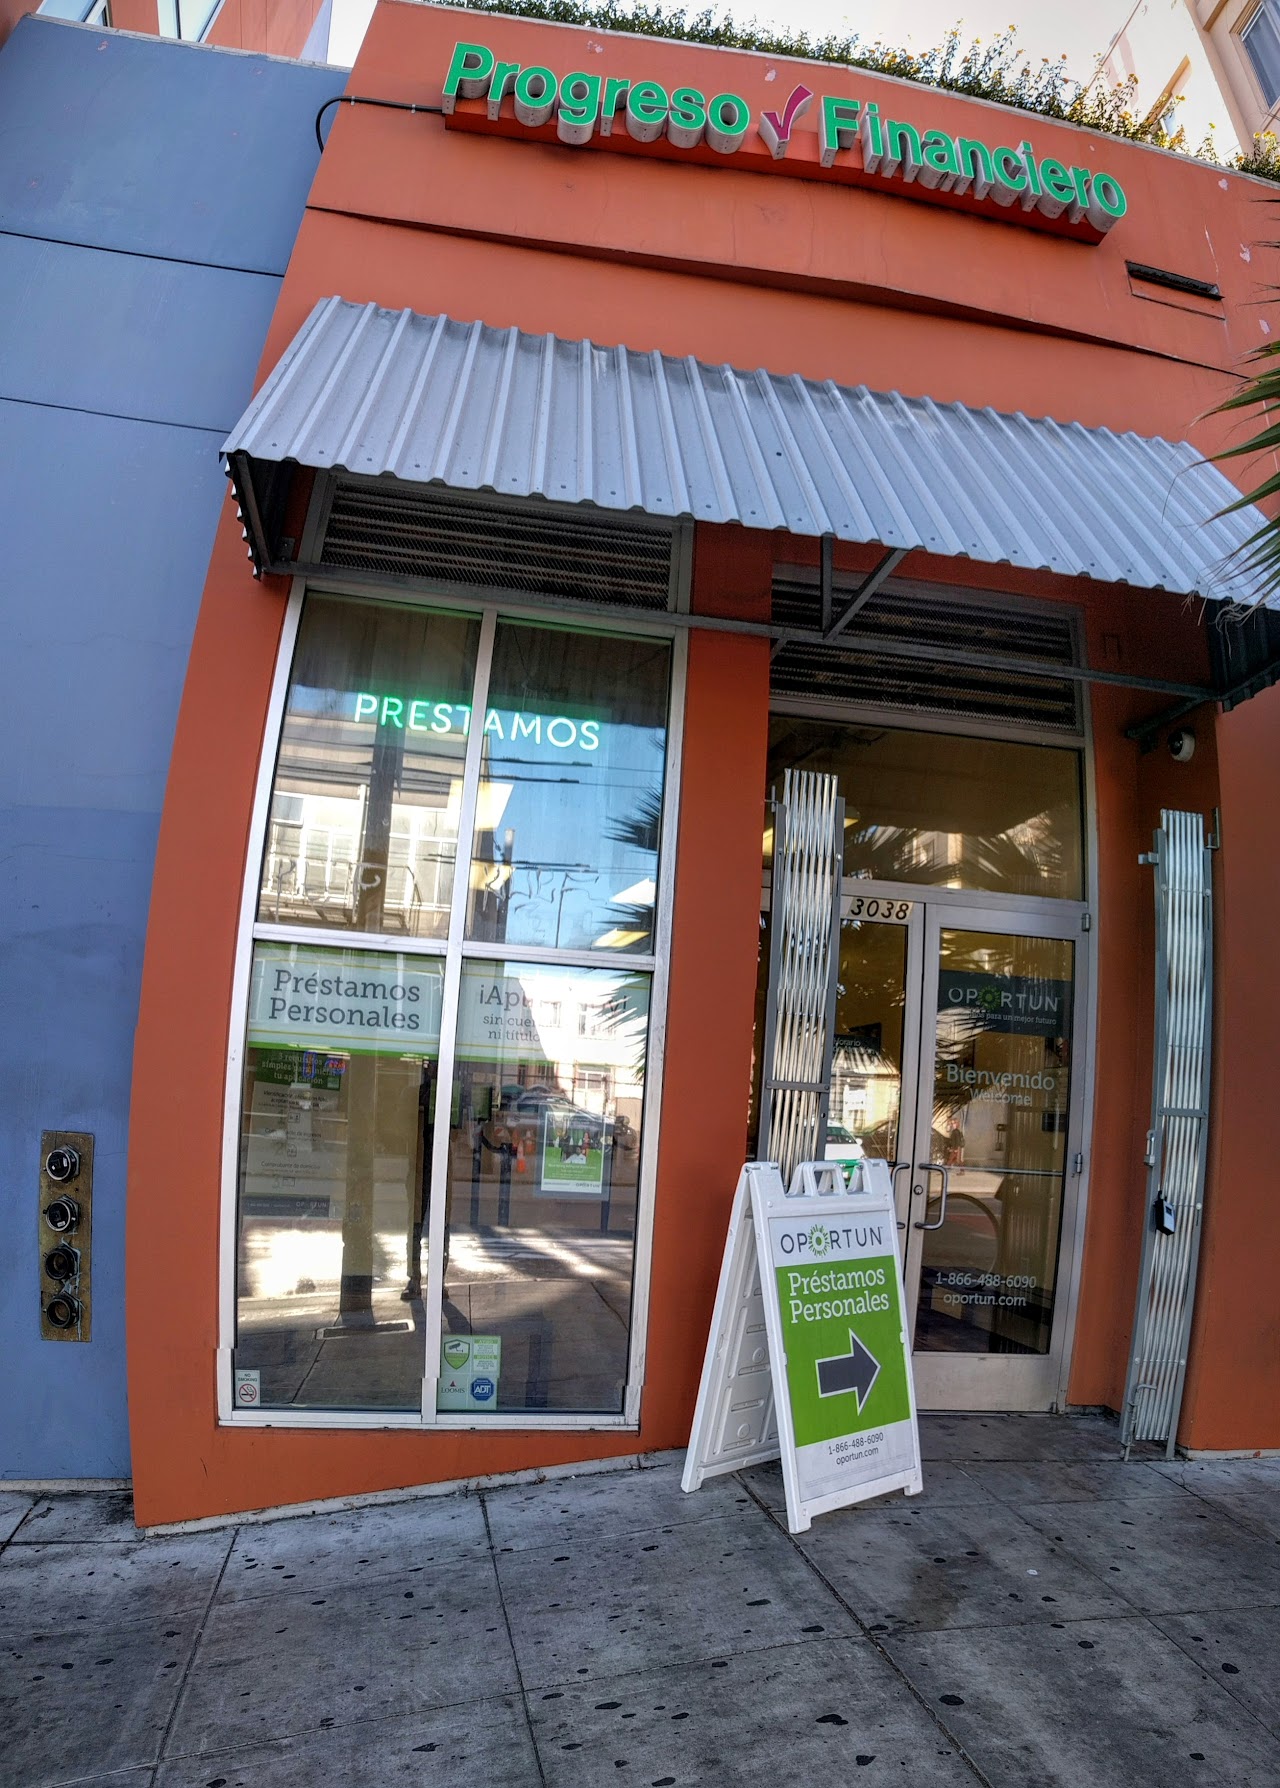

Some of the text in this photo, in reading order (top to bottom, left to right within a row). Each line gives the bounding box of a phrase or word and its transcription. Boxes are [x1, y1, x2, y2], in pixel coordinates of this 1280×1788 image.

[443, 41, 1129, 219] Progreso Financiero
[353, 692, 601, 752] PRESTAMOS
[850, 898, 910, 920] 3038
[273, 969, 420, 1002] Préstamos
[948, 986, 1059, 1012] OPORTUN
[268, 997, 420, 1030] Personales
[482, 1013, 536, 1028] sin cue
[986, 1012, 1002, 1020] para
[1013, 1015, 1034, 1024] mejor
[1035, 1015, 1057, 1025] futuro
[488, 1029, 502, 1040] ni
[946, 1063, 1055, 1091] Bienvenido
[970, 1088, 1031, 1106] Welcome
[780, 1225, 883, 1256] OPORTUN
[787, 1268, 886, 1297] Préstamos
[935, 1272, 1037, 1289] 1-866-488-6090
[789, 1290, 890, 1324] Personales
[943, 1293, 1027, 1307] oportun.com
[473, 1385, 491, 1394] ADT
[828, 1432, 884, 1455] 1-866-488-6090
[836, 1447, 879, 1466] oportun.com
